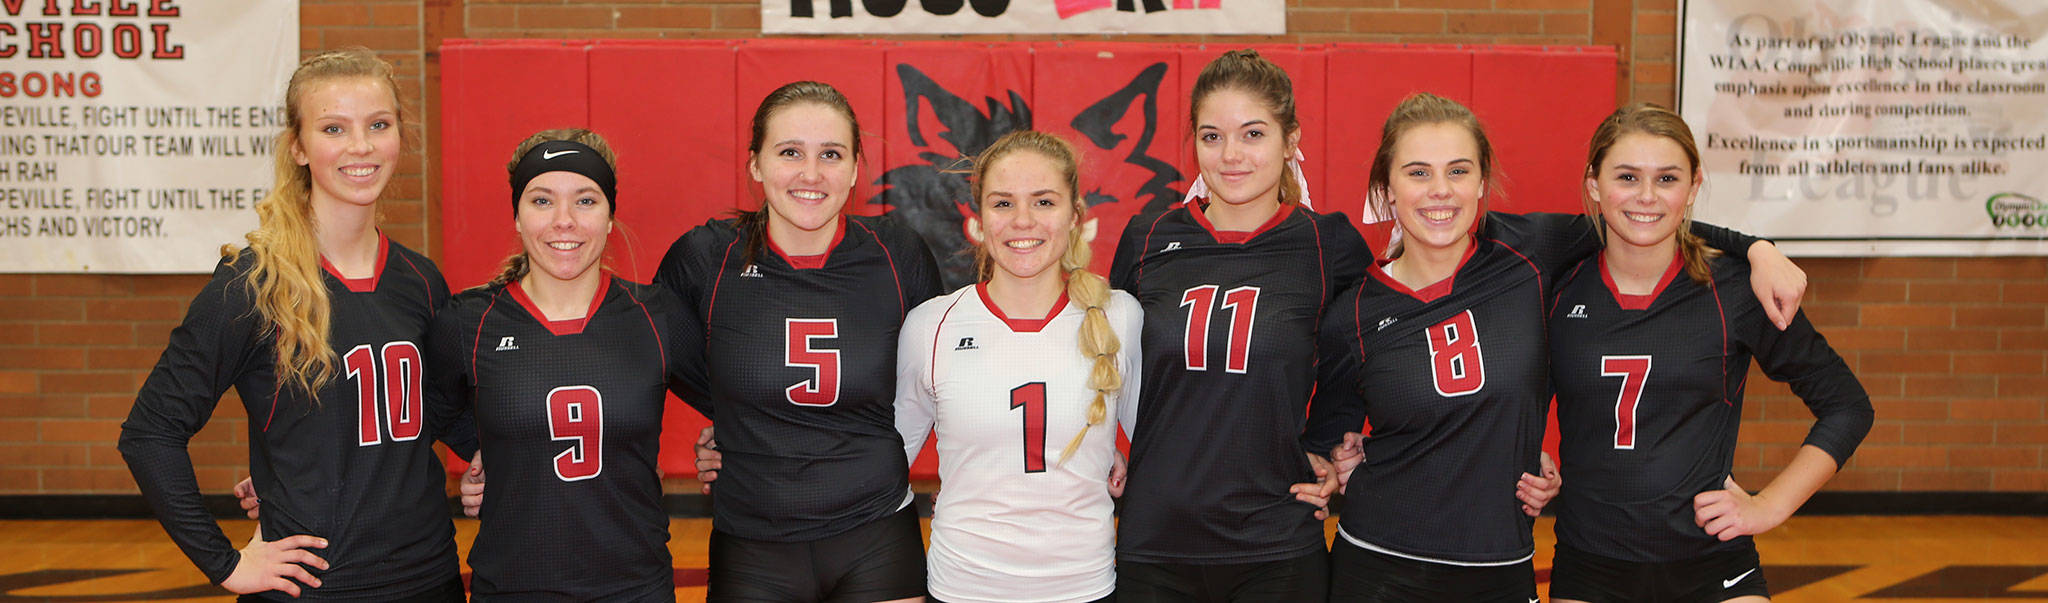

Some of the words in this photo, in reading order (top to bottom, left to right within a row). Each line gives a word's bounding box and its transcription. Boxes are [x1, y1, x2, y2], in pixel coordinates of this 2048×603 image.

[1730, 33, 1752, 48] As
[1756, 36, 1792, 51] part
[1797, 36, 1816, 49] of
[1910, 31, 1968, 49] League
[1973, 35, 2001, 48] and
[2006, 34, 2032, 48] the
[1710, 54, 1768, 72] WIAA,
[1860, 55, 1892, 71] High
[1899, 56, 1953, 70] School
[1958, 57, 2007, 74] places
[0, 72, 102, 98] SONG
[1714, 80, 1787, 97] emphasis
[1792, 84, 1831, 98] upon
[1836, 79, 1910, 95] excellence
[1915, 80, 1931, 94] in
[1937, 80, 1961, 94] the
[1967, 79, 2046, 94] classroom
[83, 105, 138, 127] FIGHT
[145, 106, 202, 127] UNTIL
[207, 106, 242, 127] THE
[1784, 103, 1813, 118] and
[1819, 103, 1871, 119] during
[1875, 103, 1972, 119] competition.
[43, 135, 90, 156] THAT
[94, 135, 137, 156] OUR
[143, 135, 193, 156] TEAM
[200, 135, 245, 156] WILL
[1707, 133, 1797, 151] Excellence
[1803, 136, 1819, 150] in
[1827, 134, 1948, 154] sportsmanship
[1954, 134, 1966, 149] is
[1973, 135, 2046, 155] expected
[17, 161, 57, 182] RAH
[1739, 160, 1780, 175] from
[1788, 160, 1809, 175] all
[1881, 160, 1911, 175] and
[1918, 160, 1954, 175] fans
[1961, 160, 2006, 175] alike.
[87, 188, 141, 210] FIGHT
[147, 188, 205, 210] UNTIL
[209, 188, 245, 210] THE
[38, 215, 78, 238] AND
[83, 215, 168, 238] VICTORY.
[1179, 284, 1261, 374] 11
[785, 317, 841, 407] 5
[1425, 309, 1485, 398] 8
[343, 341, 423, 446] 10
[1600, 355, 1652, 450] 7
[546, 385, 602, 482] 9
[1010, 382, 1047, 473] 1
